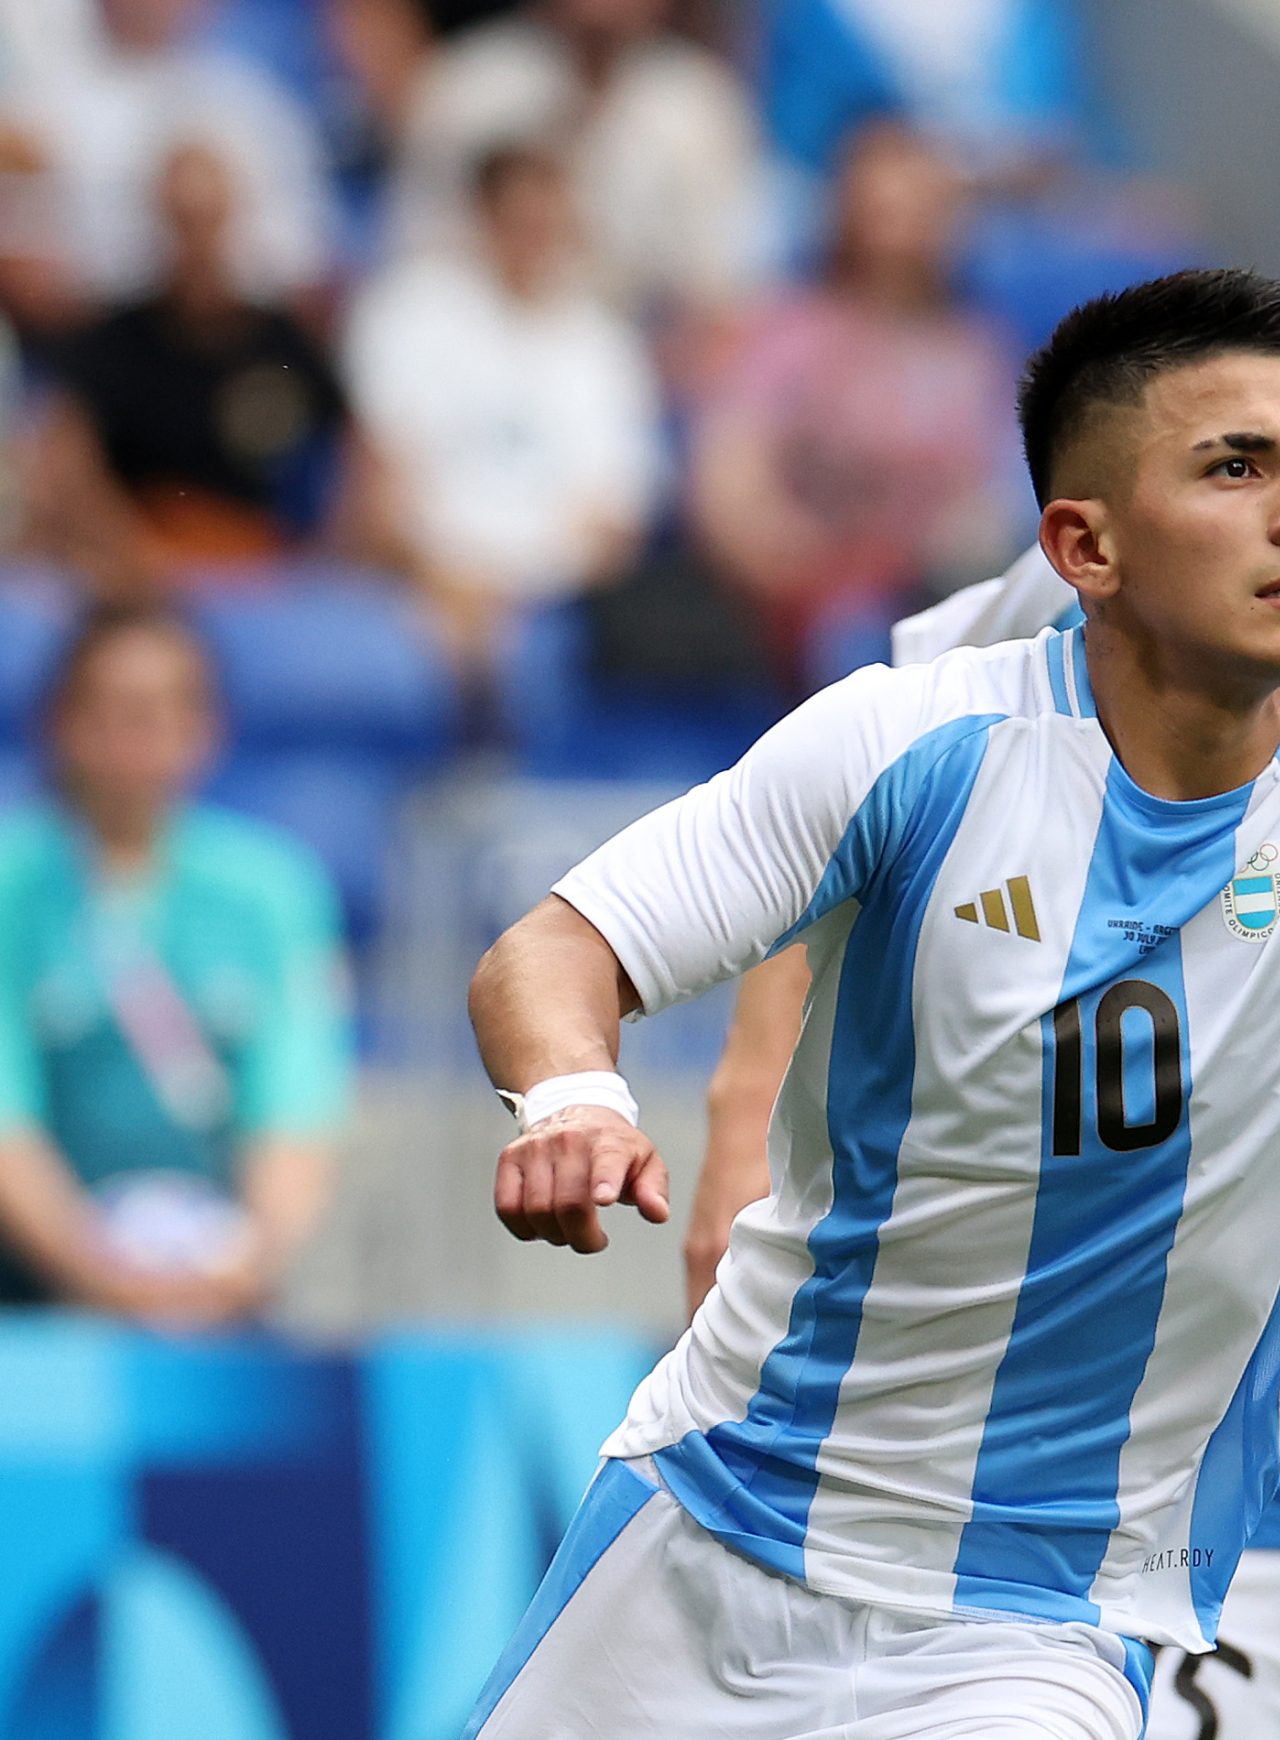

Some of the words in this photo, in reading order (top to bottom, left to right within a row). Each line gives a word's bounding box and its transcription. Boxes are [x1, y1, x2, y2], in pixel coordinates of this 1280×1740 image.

[1223, 885, 1233, 914] OMITE
[1053, 979, 1183, 1156] 10
[1141, 1548, 1215, 1573] HEAT.RDY
